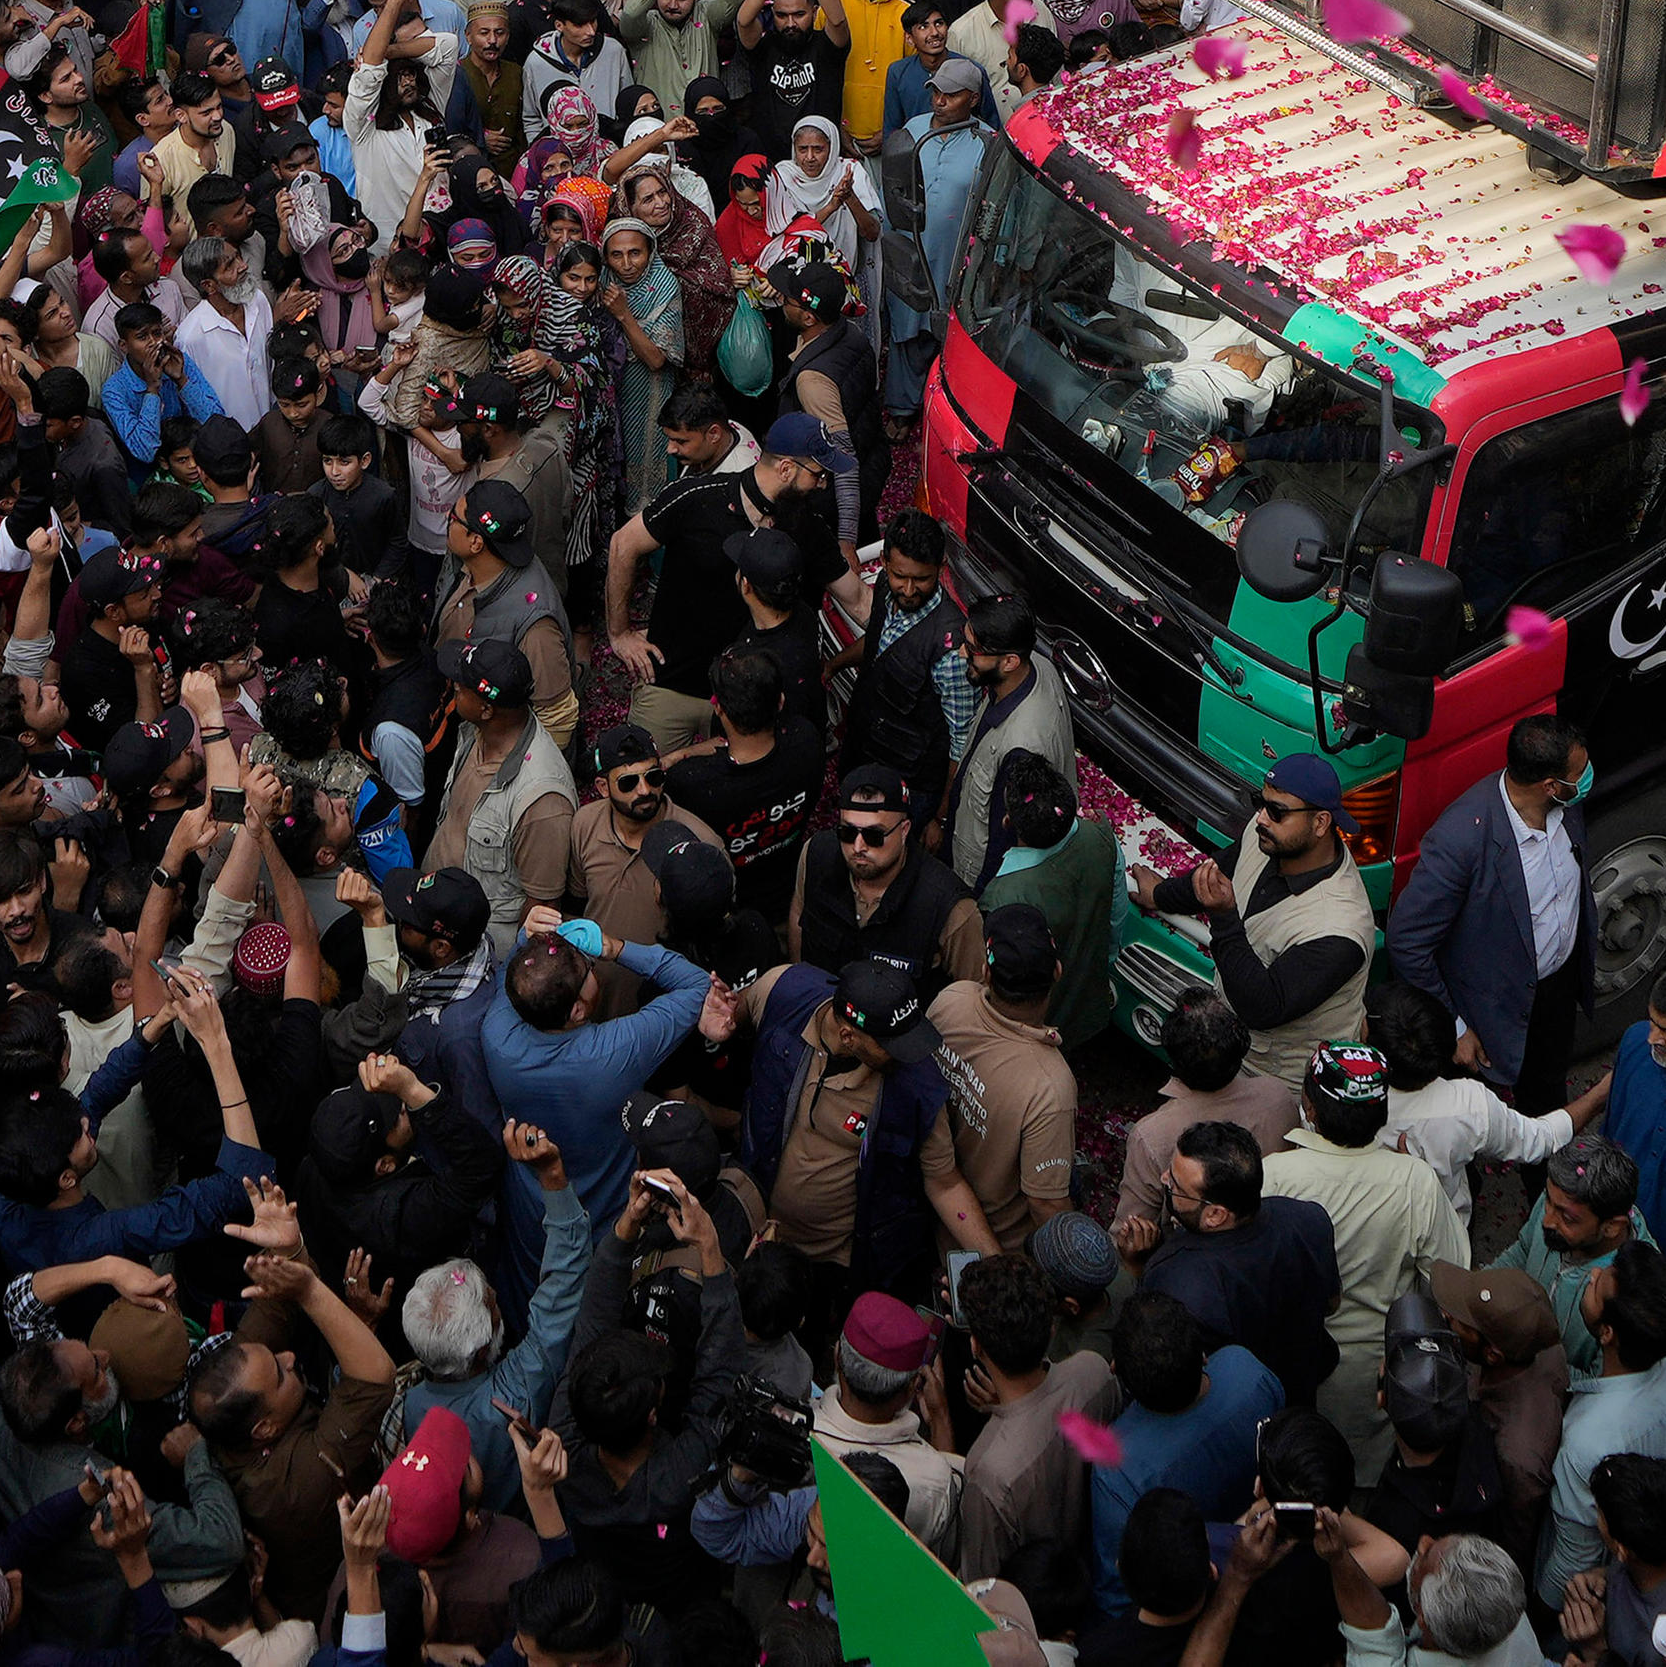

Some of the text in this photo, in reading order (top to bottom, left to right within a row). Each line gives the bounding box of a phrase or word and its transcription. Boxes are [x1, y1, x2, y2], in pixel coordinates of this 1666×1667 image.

[769, 791, 806, 822] چنو
[729, 832, 759, 853] کو
[938, 1044, 987, 1099] JAN NISAR
